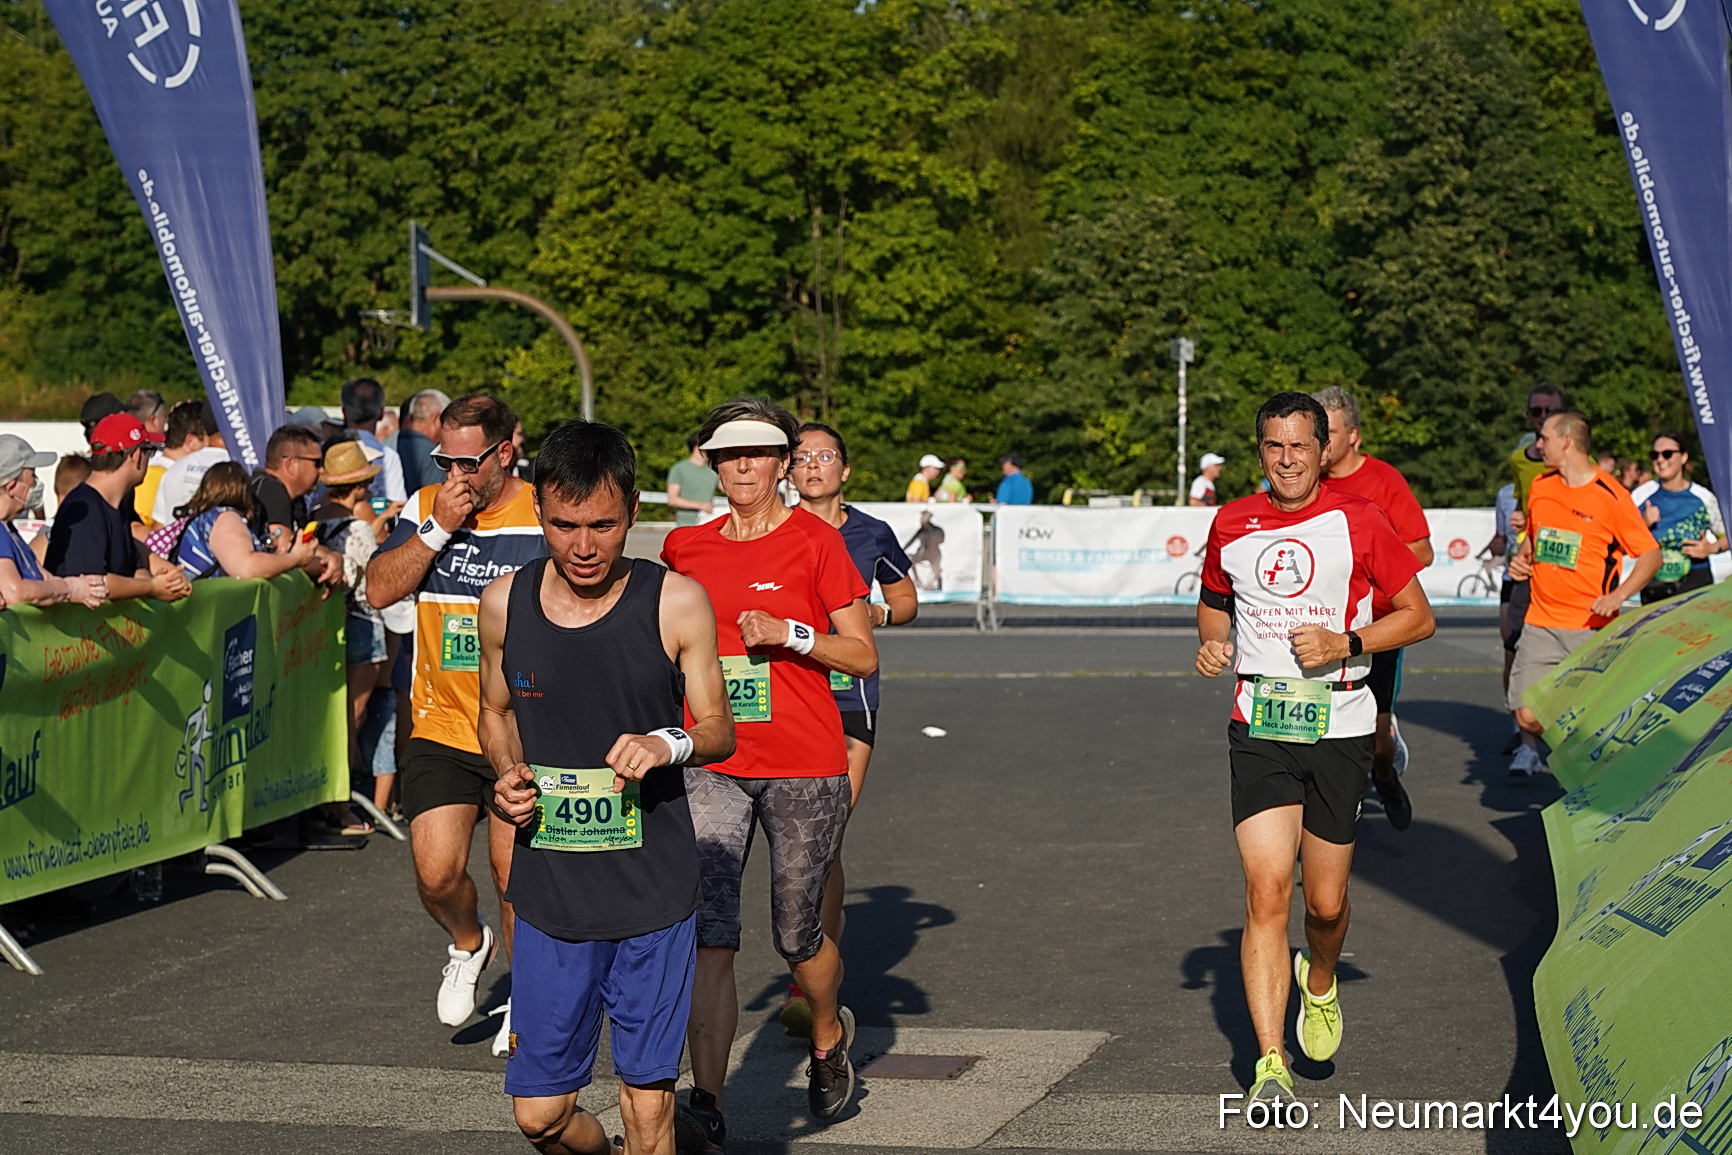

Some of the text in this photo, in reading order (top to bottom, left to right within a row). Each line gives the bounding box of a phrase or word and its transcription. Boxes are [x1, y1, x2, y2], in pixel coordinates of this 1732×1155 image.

[1543, 540, 1571, 556] 1401
[1247, 605, 1337, 617] LAUFEN MIT HERZ
[453, 634, 481, 654] 18
[451, 654, 475, 662] Siebald
[758, 681, 767, 712] 2022
[1255, 704, 1263, 727] RUN
[1264, 698, 1318, 724] 1146
[1262, 720, 1317, 732] Heck Johannes
[1317, 707, 1327, 736] 2022
[556, 783, 591, 791] Firmenlauf
[555, 797, 612, 825] 490
[625, 799, 636, 836] 2022
[546, 825, 626, 836] Distler Johanna
